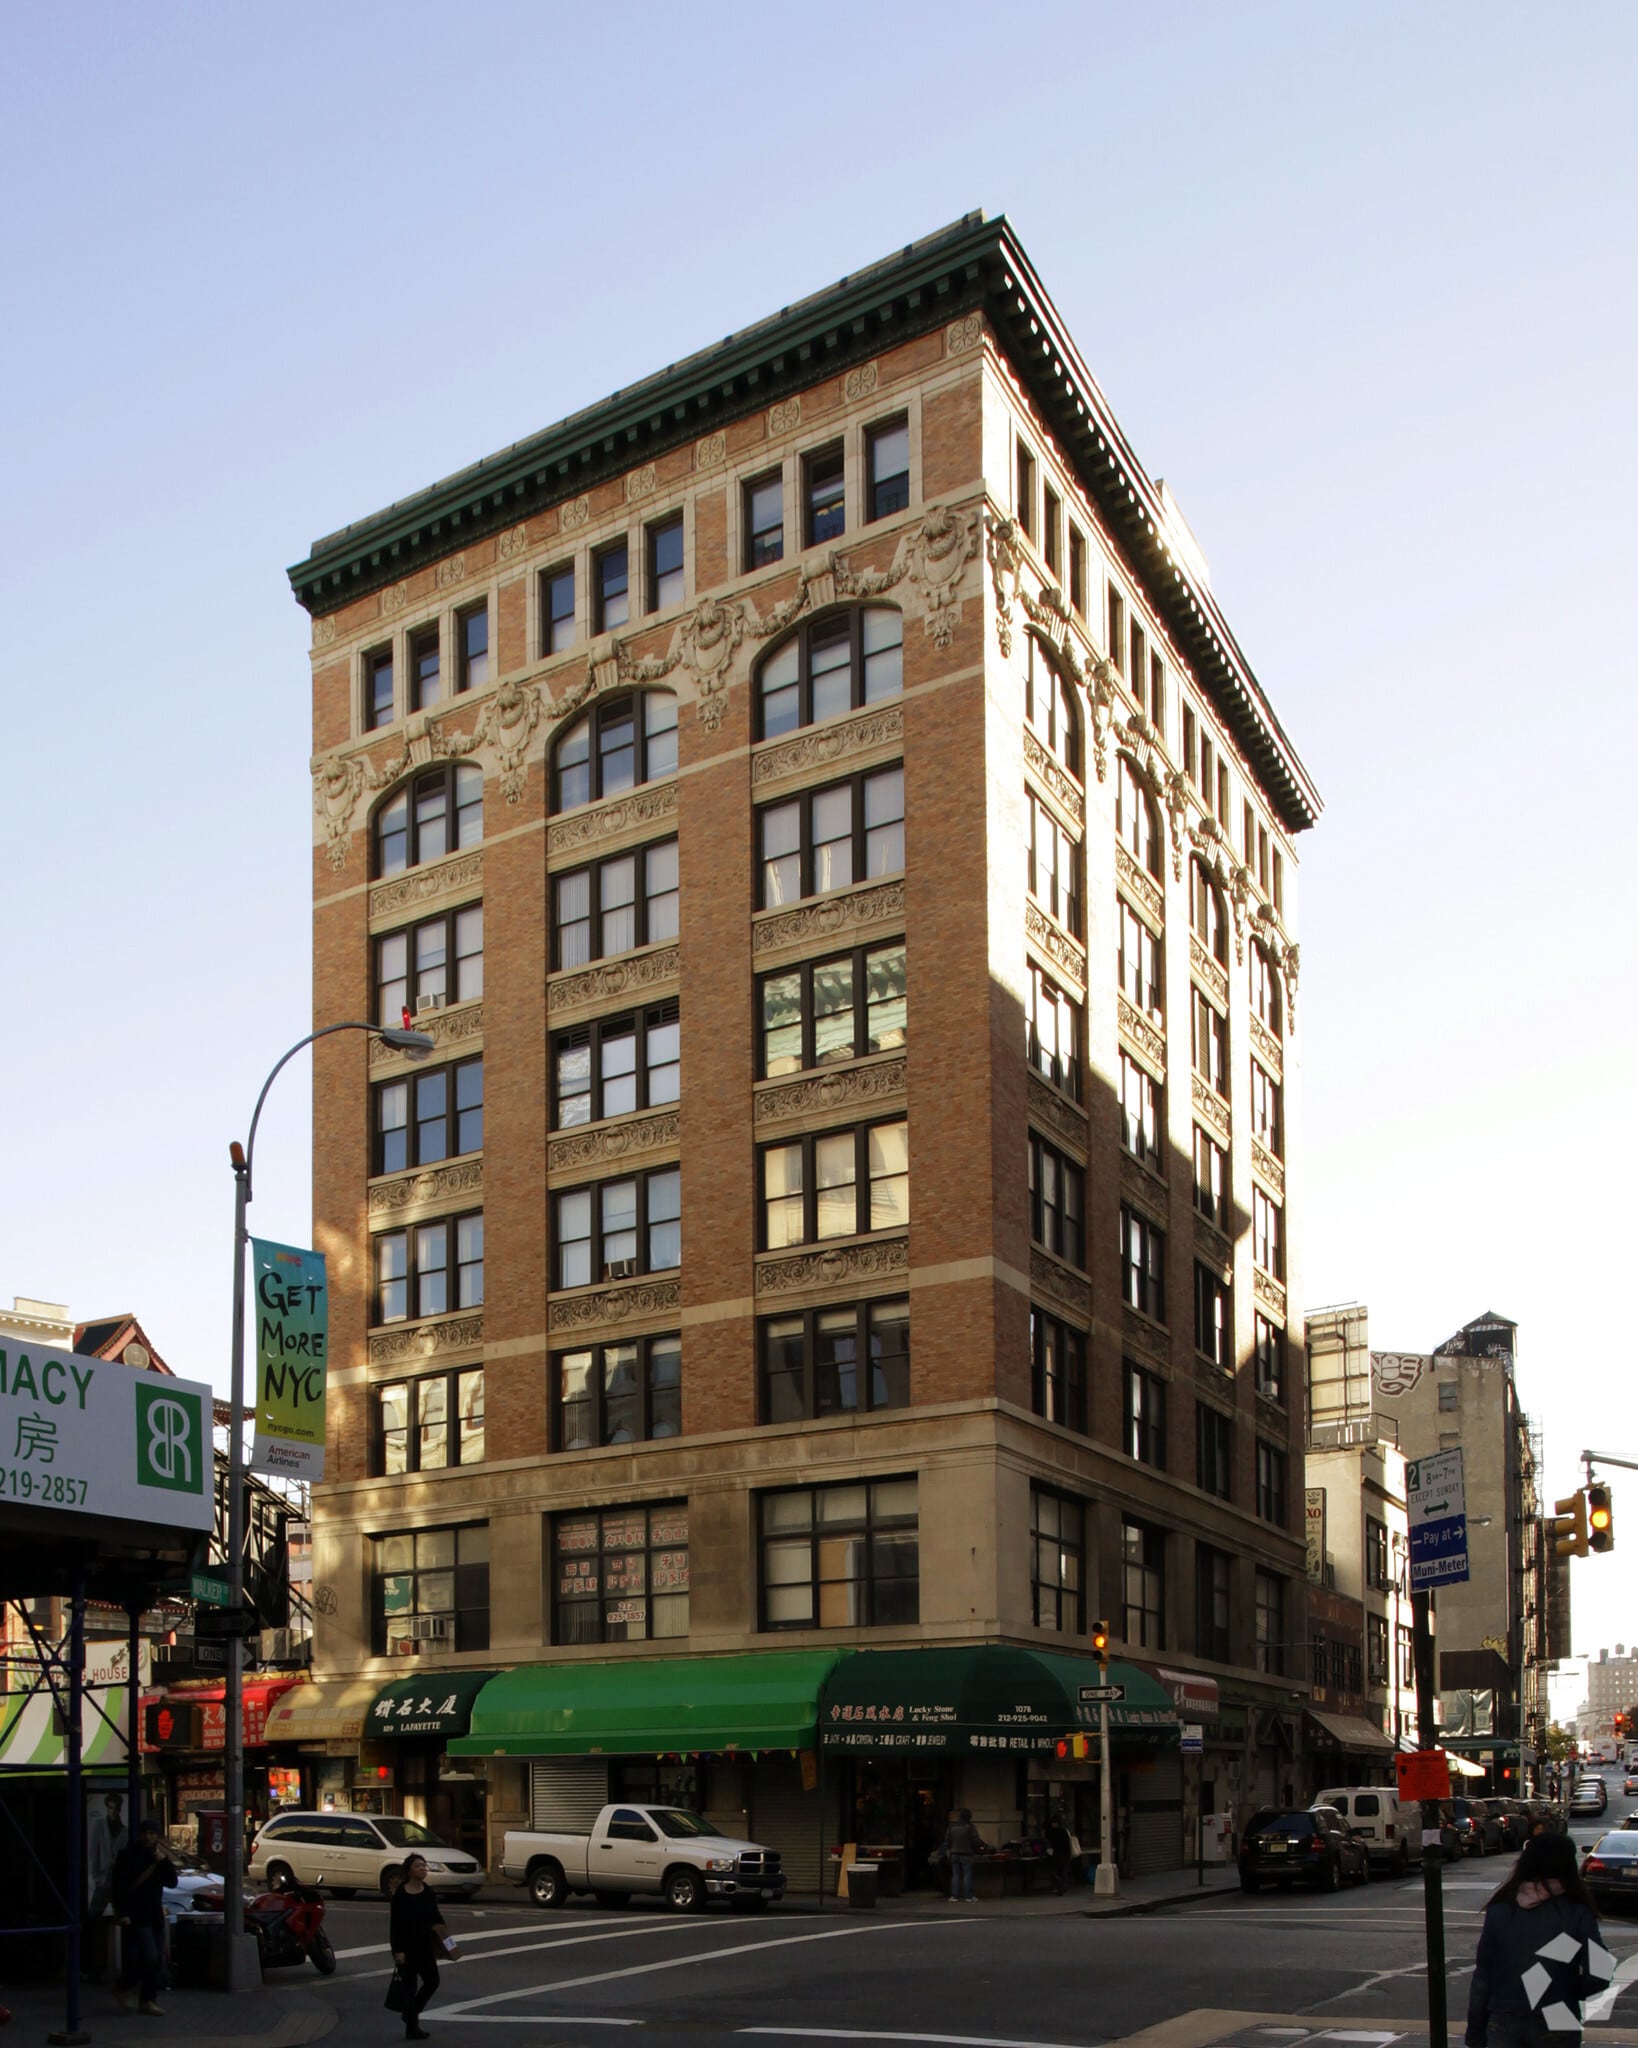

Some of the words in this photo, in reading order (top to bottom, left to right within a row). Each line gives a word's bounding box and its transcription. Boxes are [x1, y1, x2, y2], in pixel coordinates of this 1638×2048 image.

[259, 1272, 324, 1318] GET
[262, 1317, 325, 1358] MORE
[265, 1362, 322, 1408] NYC
[14, 1411, 59, 1463] 房
[267, 1423, 315, 1437] nycgo.com
[268, 1445, 311, 1460] American
[267, 1455, 300, 1468] Airlines
[1408, 1464, 1418, 1491] 2
[1411, 1490, 1434, 1505] EXCEPT
[1436, 1482, 1459, 1497] SUNDAY
[1306, 1508, 1321, 1519] XO
[1423, 1531, 1440, 1547] Pay
[1441, 1527, 1452, 1542] at
[1413, 1558, 1466, 1578] Muni-Meter
[193, 1578, 222, 1601] WALKER
[618, 1601, 634, 1611] 212
[93, 1666, 128, 1681] HOUSE
[1085, 1690, 1098, 1698] ONE
[909, 1706, 931, 1714] Lucky
[934, 1705, 954, 1713] Stone
[400, 1721, 441, 1732] LAFAYETTE
[1009, 1737, 1030, 1749] RETAIL
